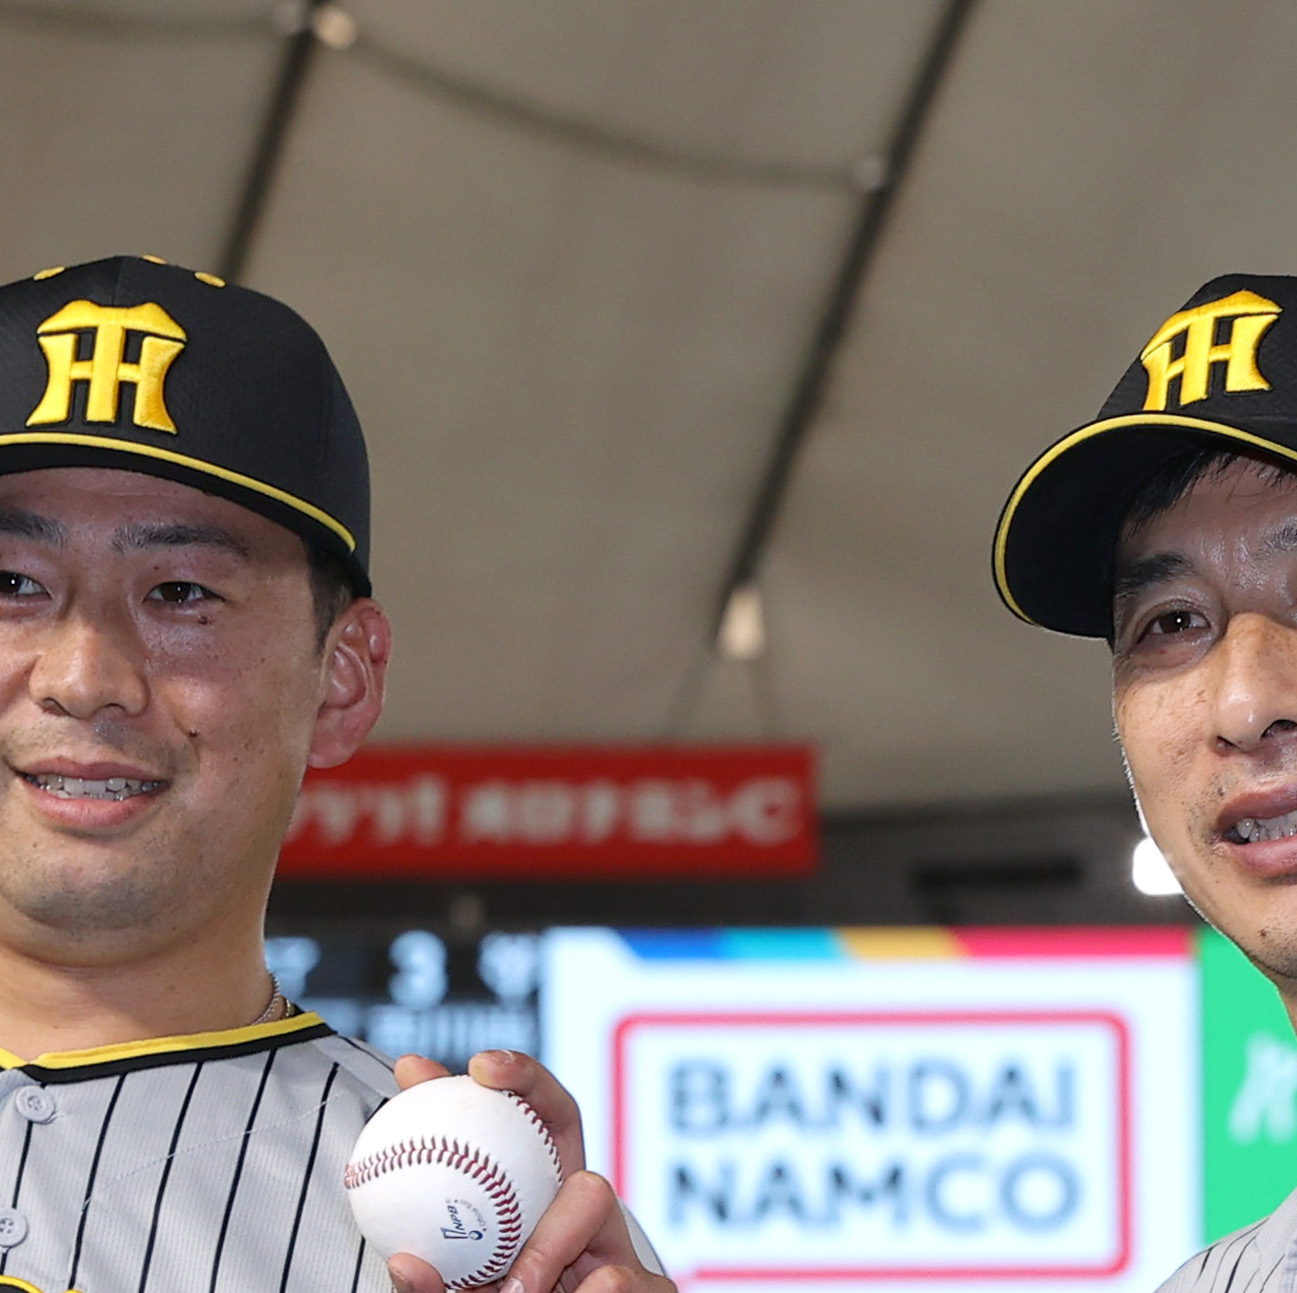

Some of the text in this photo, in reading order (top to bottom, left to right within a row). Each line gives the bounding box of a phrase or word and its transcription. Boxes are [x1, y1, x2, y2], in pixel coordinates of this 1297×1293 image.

[670, 1056, 1078, 1136] BANDAI
[447, 1204, 465, 1231] NPB
[670, 1154, 1080, 1234] NAMCO
